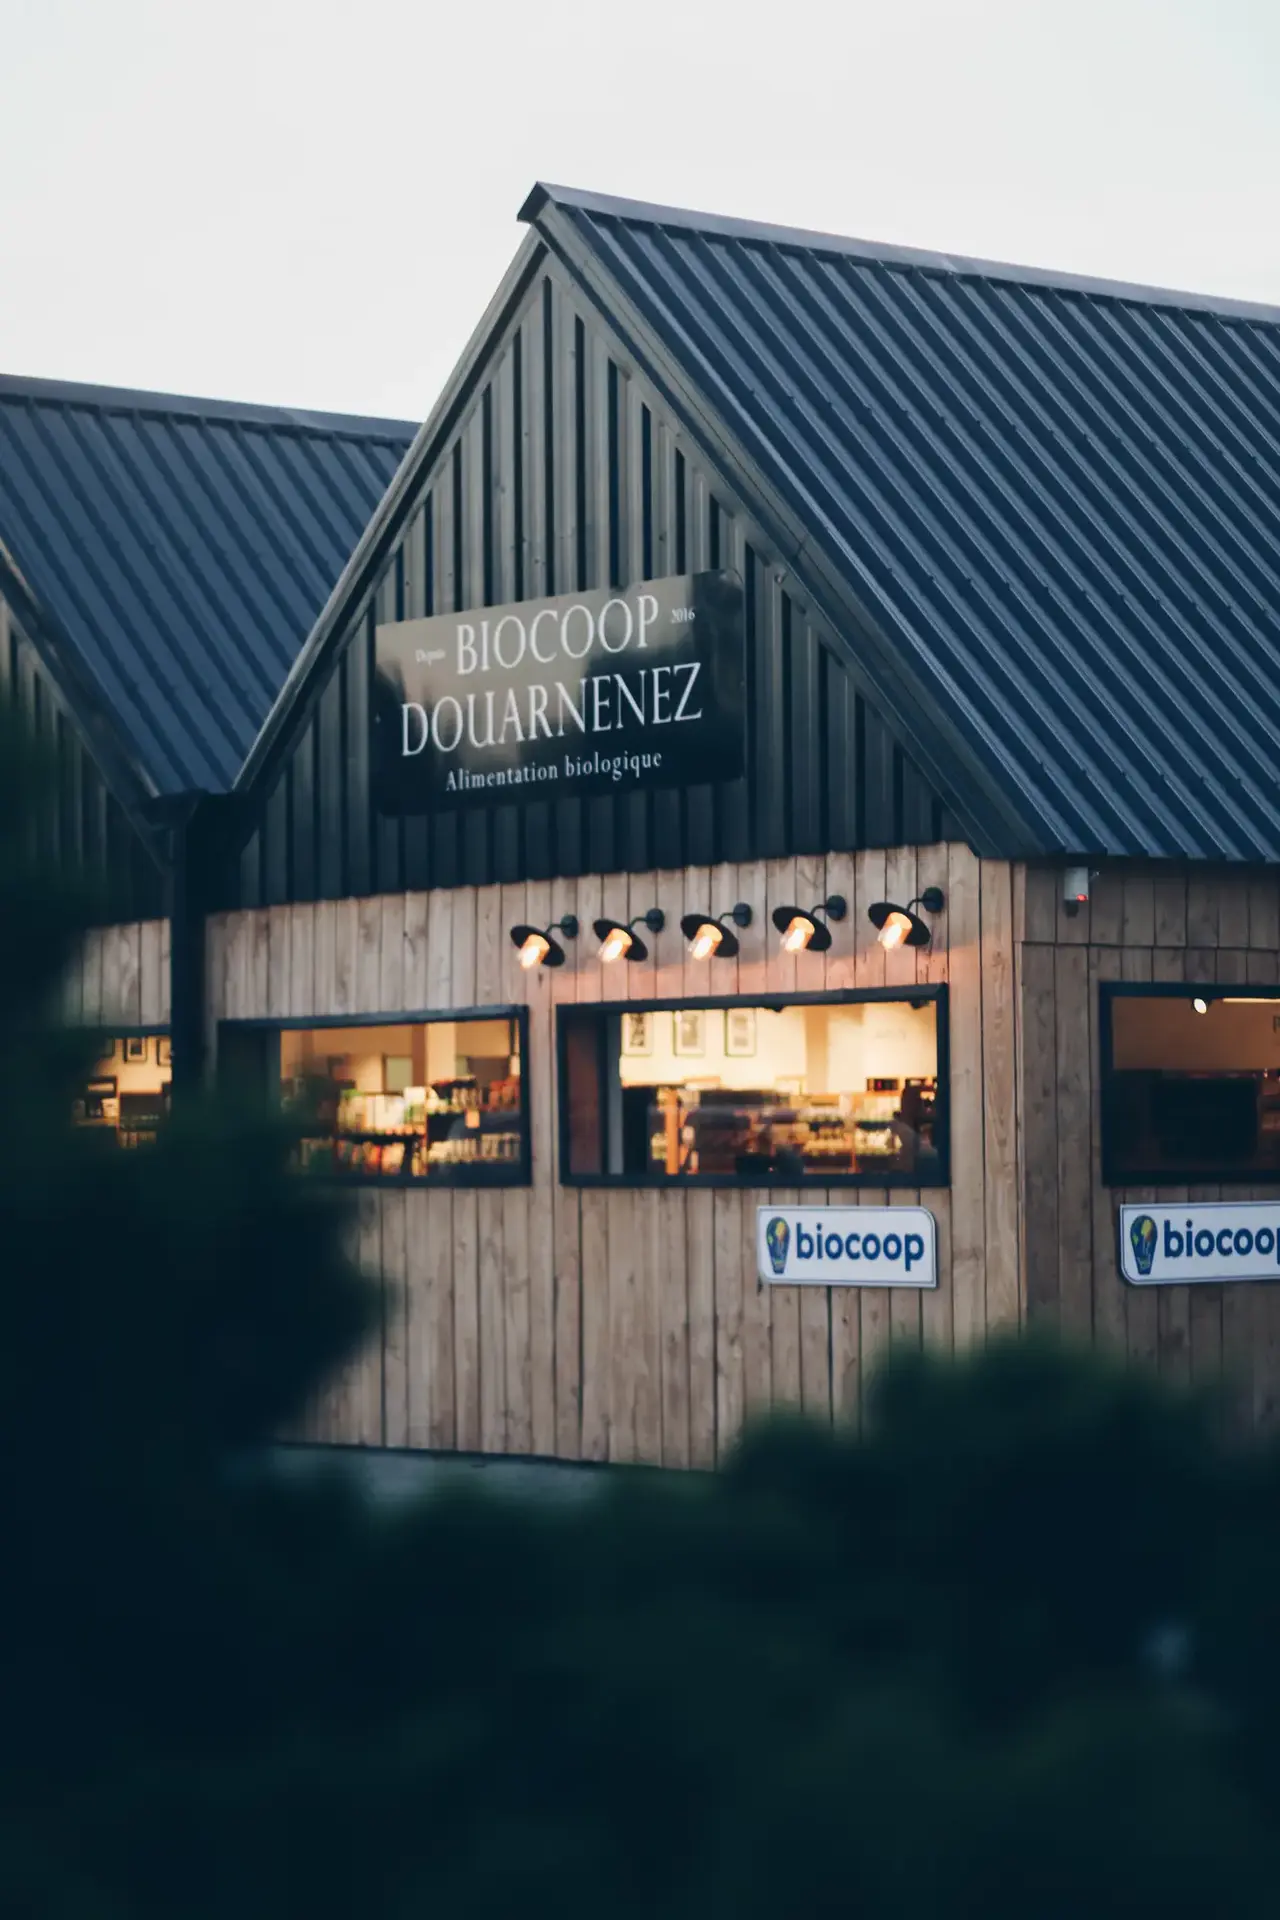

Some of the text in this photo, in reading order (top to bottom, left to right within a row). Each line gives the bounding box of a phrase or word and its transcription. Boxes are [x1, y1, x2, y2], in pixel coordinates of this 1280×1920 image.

[456, 595, 659, 675] BIOCOOP
[401, 662, 703, 757] DOUARNENEZ
[446, 751, 662, 792] Alimentation biologique
[796, 1222, 925, 1272] biocoop
[1164, 1219, 1280, 1265] biocoo
